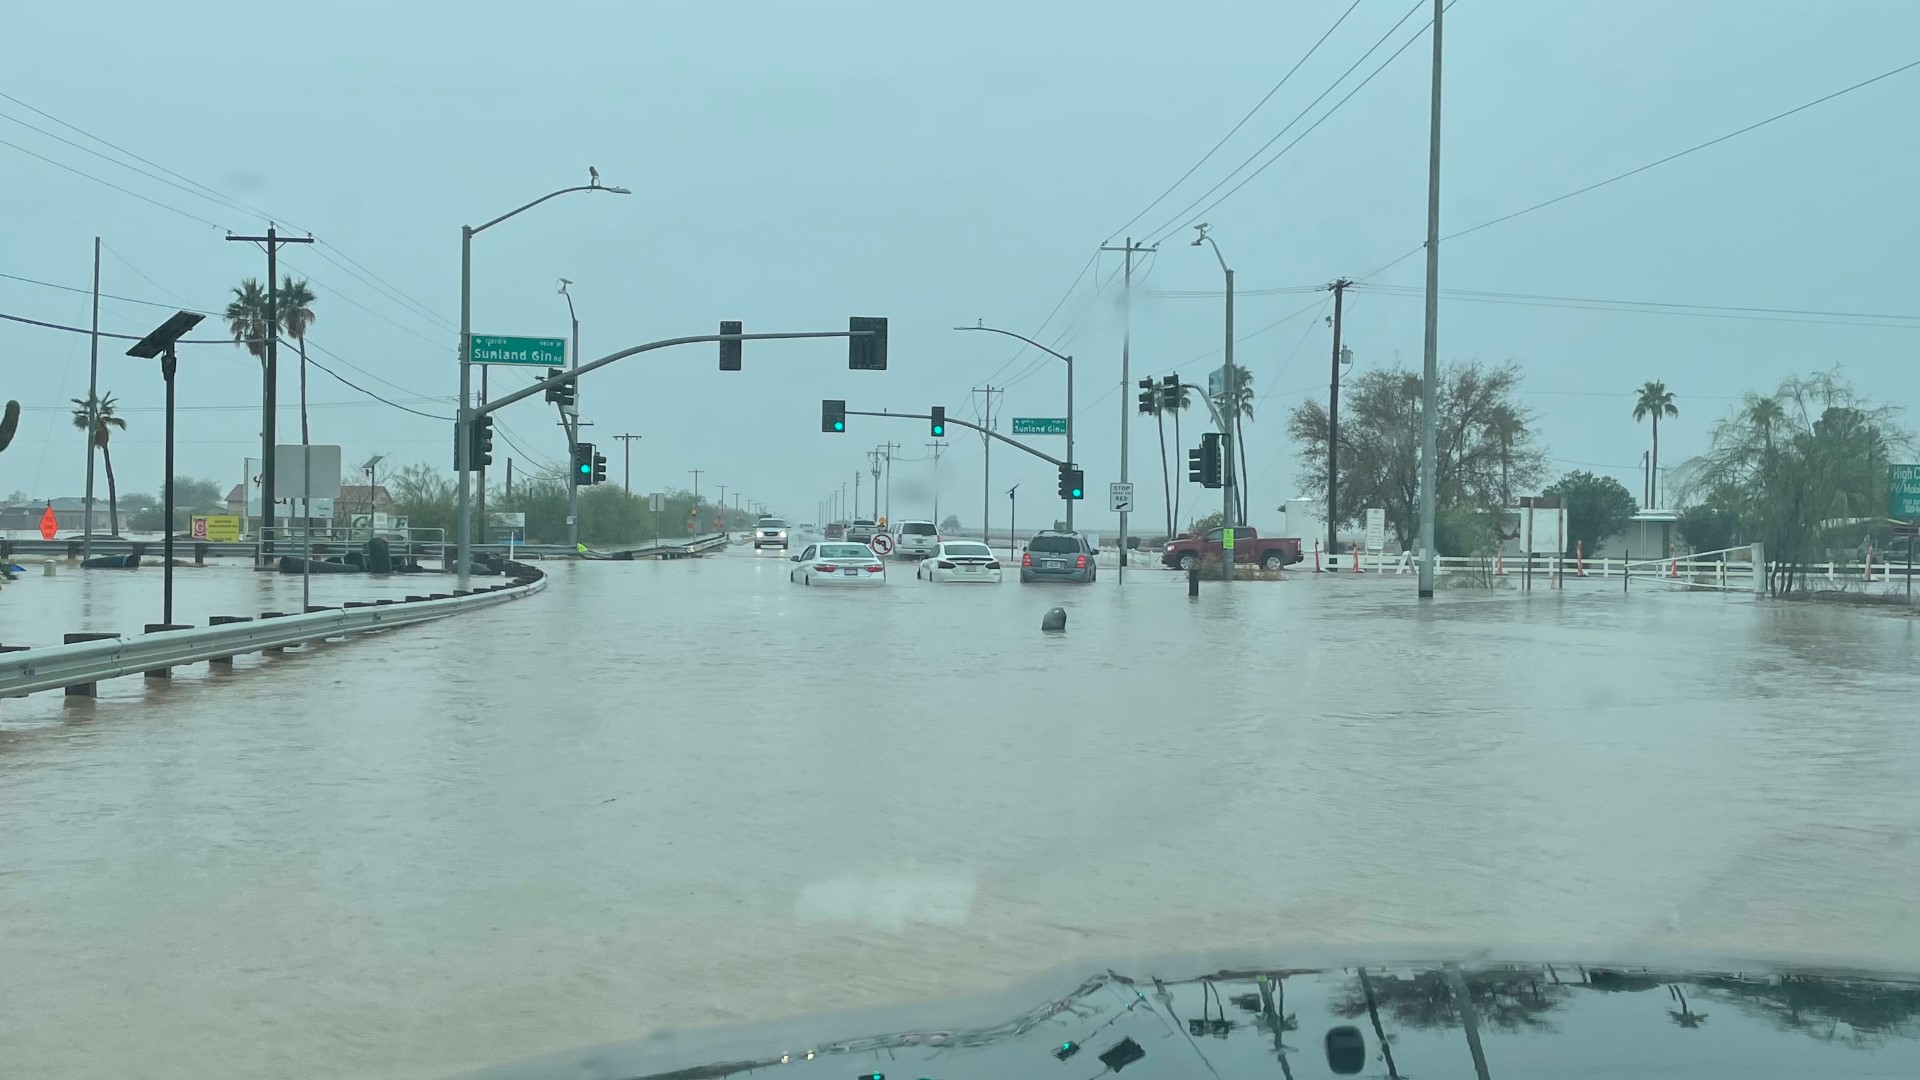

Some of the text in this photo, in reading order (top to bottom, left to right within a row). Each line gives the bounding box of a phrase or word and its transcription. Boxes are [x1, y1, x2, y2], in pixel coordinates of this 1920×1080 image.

[474, 348, 527, 361] Sunland
[531, 350, 552, 362] Gin
[1014, 425, 1045, 433] Sunland
[1047, 425, 1060, 433] Gin
[1893, 466, 1913, 482] High
